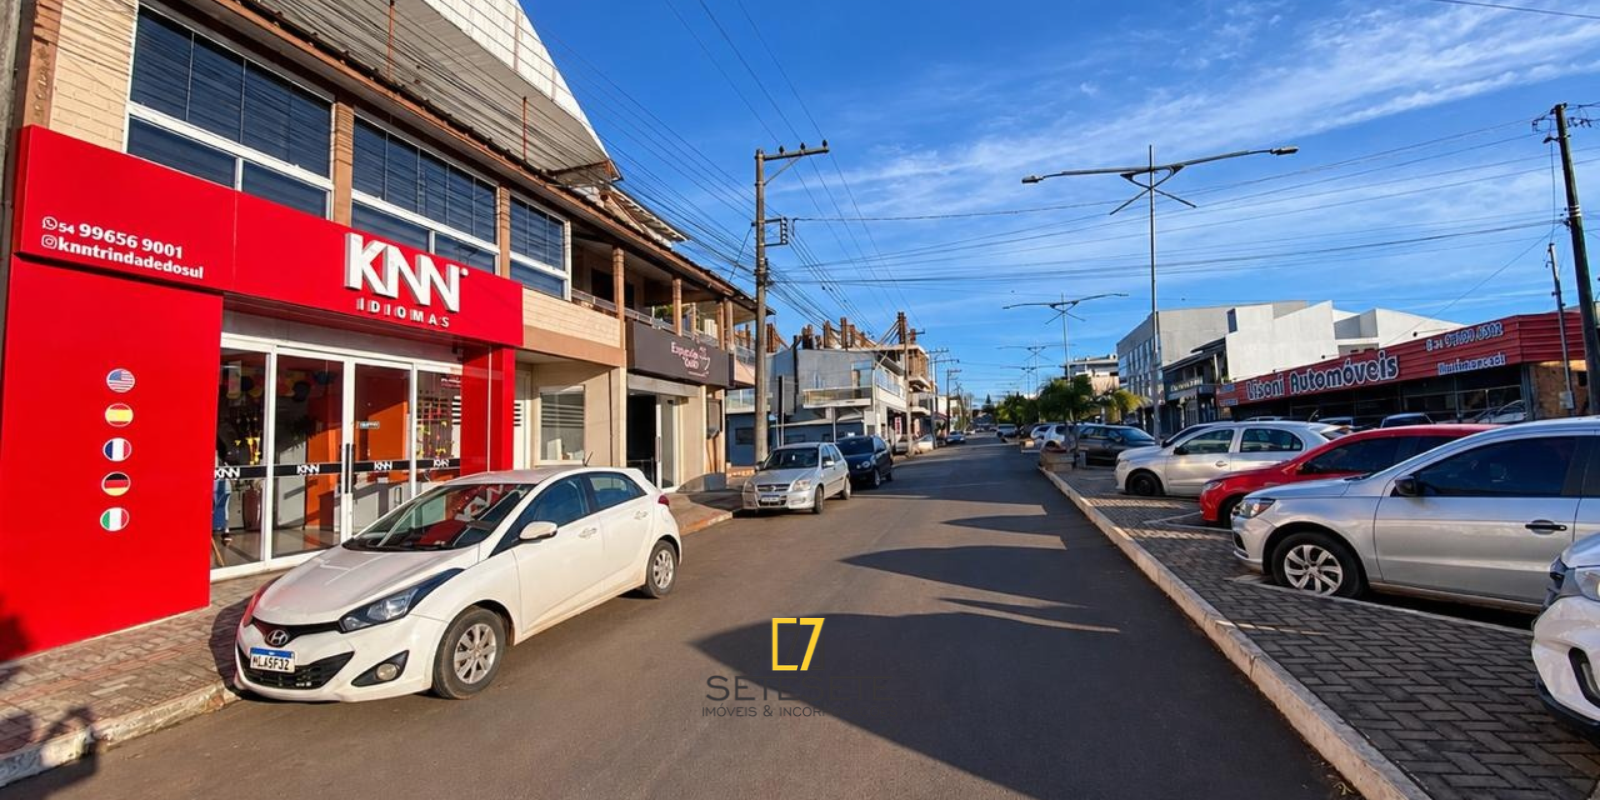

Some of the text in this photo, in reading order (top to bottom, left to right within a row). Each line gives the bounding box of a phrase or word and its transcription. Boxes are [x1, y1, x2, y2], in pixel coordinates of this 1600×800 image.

[57, 236, 204, 279] knntrindadedosul
[58, 222, 183, 259] 54 99656 9001
[345, 232, 460, 313] KNN
[356, 297, 450, 328] IDIOMAS
[1246, 350, 1398, 400] Lisoni Automóveis
[214, 467, 241, 479] KNN
[297, 464, 320, 475] KNN
[374, 461, 392, 470] KNN
